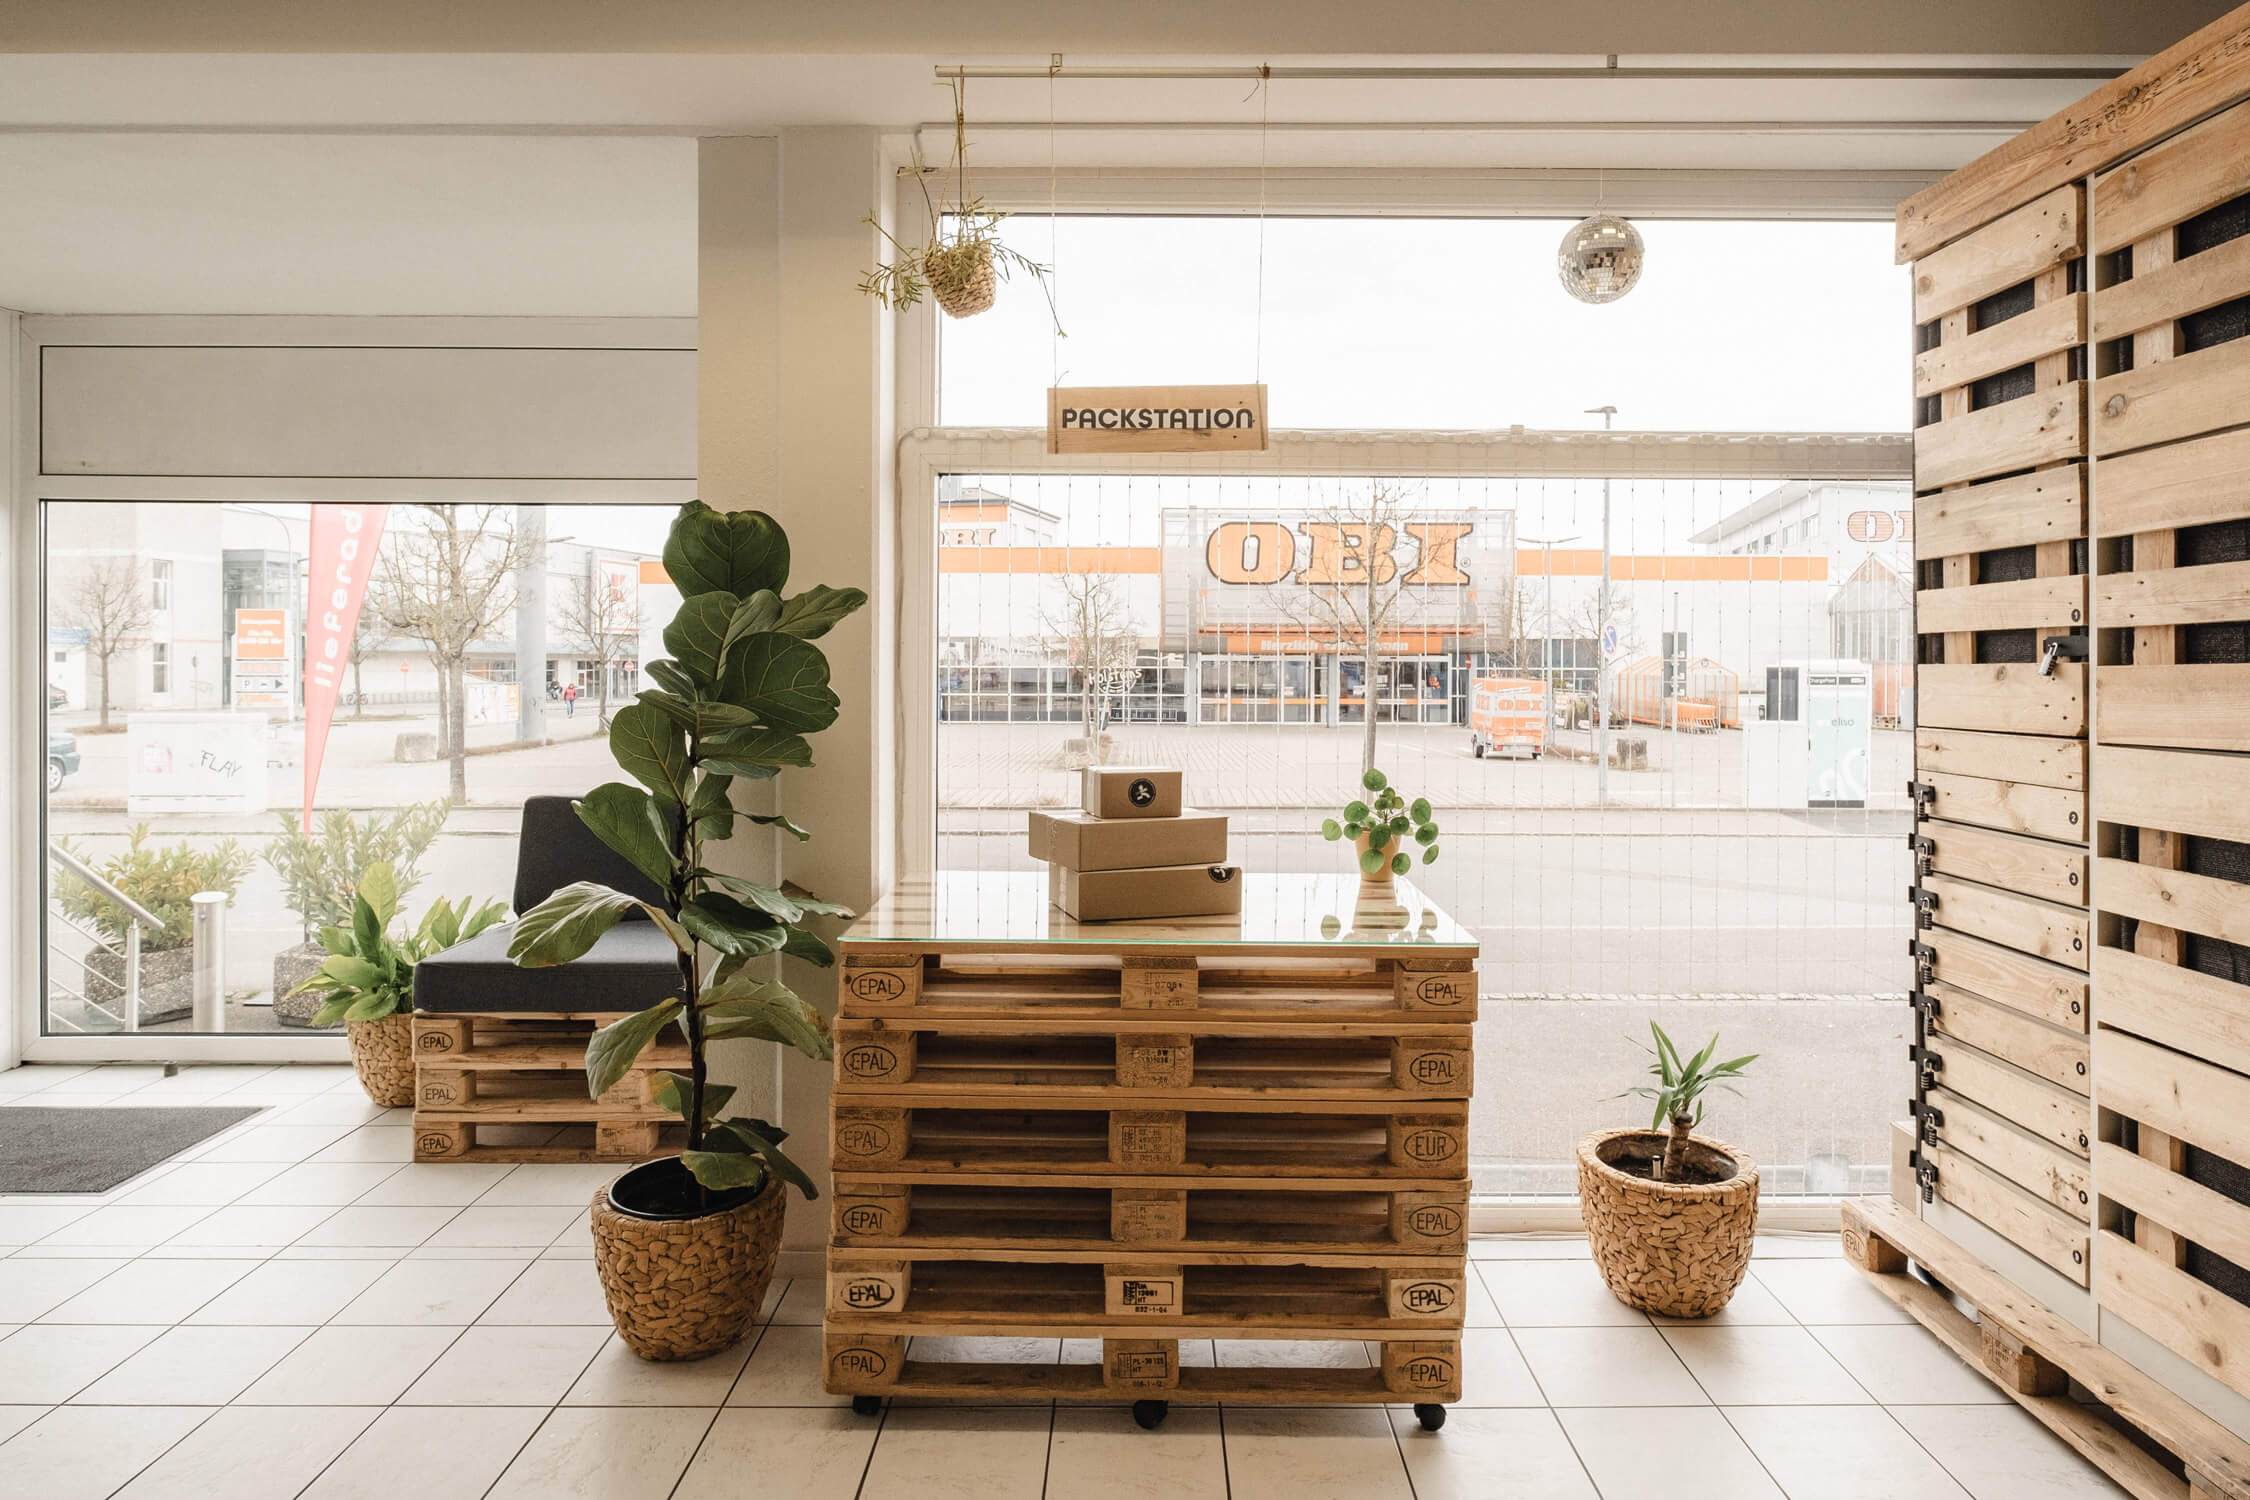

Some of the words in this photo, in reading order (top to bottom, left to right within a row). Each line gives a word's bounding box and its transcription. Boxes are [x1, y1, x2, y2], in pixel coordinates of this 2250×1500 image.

[1062, 407, 1254, 430] PACKSTATION
[1206, 521, 1474, 585] OBI
[859, 978, 897, 996] EPAL
[1425, 983, 1462, 999] EPAL
[423, 1036, 449, 1049] EPAL
[850, 1052, 889, 1071] EPAL
[1419, 1060, 1455, 1078] EPAL
[425, 1088, 453, 1101] EPAL
[423, 1136, 449, 1150] EPAL
[843, 1130, 882, 1149] EPAL
[1415, 1136, 1447, 1156] EUR
[1416, 1213, 1454, 1230] EPAL
[1845, 1232, 1863, 1257] EPAL
[849, 1284, 886, 1302] EPAL
[1410, 1289, 1448, 1307] EPAL
[841, 1355, 879, 1373] EPAL
[1410, 1364, 1448, 1382] EPAL
